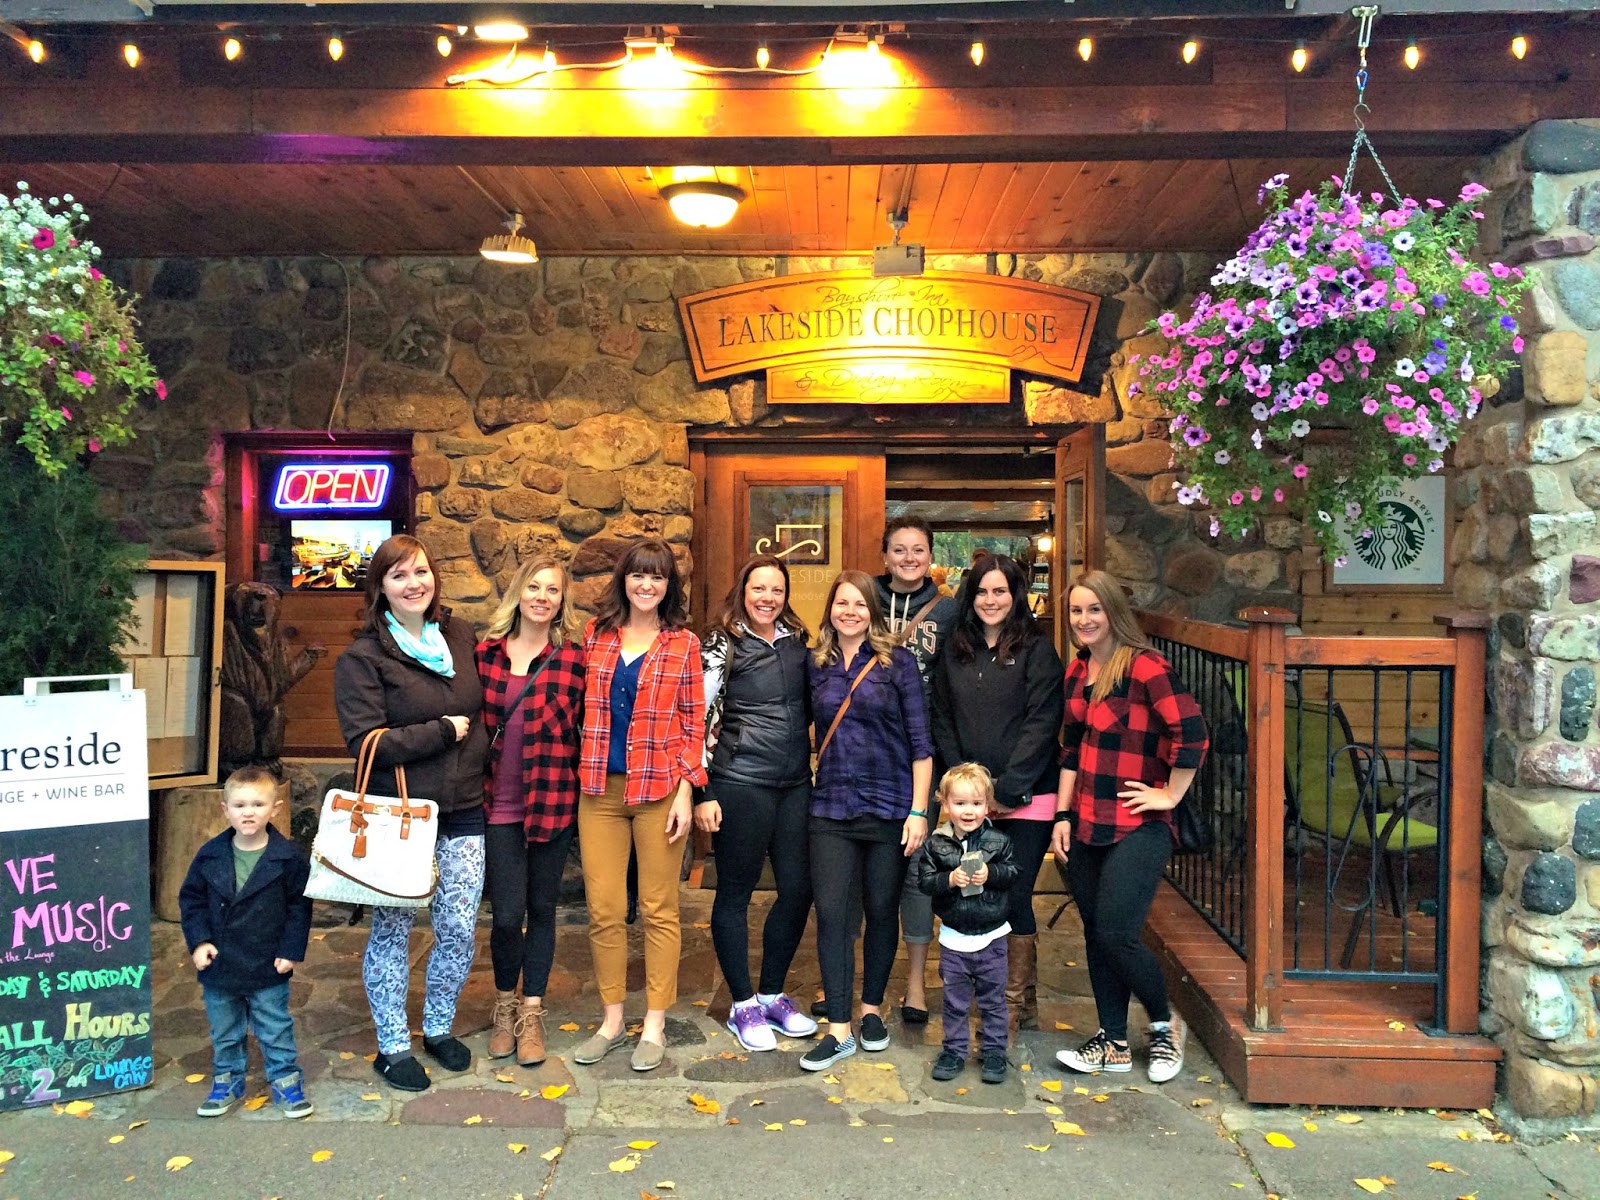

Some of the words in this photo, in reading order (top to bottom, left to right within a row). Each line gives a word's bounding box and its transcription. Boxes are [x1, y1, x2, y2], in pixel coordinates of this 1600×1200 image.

[913, 285, 949, 306] Inn
[718, 307, 864, 347] LAKESIDE
[873, 307, 1058, 344] CHOPHOUSE
[795, 371, 818, 391] &
[284, 469, 380, 505] OPEN
[1378, 489, 1406, 498] UDLY
[1408, 495, 1434, 523] SERVE
[790, 569, 833, 583] ESIDE
[0, 731, 122, 772] reside
[0, 790, 25, 804] GE
[46, 785, 88, 800] WINE
[94, 783, 125, 797] BAR
[4, 853, 57, 895] VE
[5, 951, 20, 962] the
[24, 948, 55, 964] Lounge
[0, 976, 31, 999] DAY
[57, 965, 146, 993] SATURDAY
[22, 1067, 61, 1103] 2
